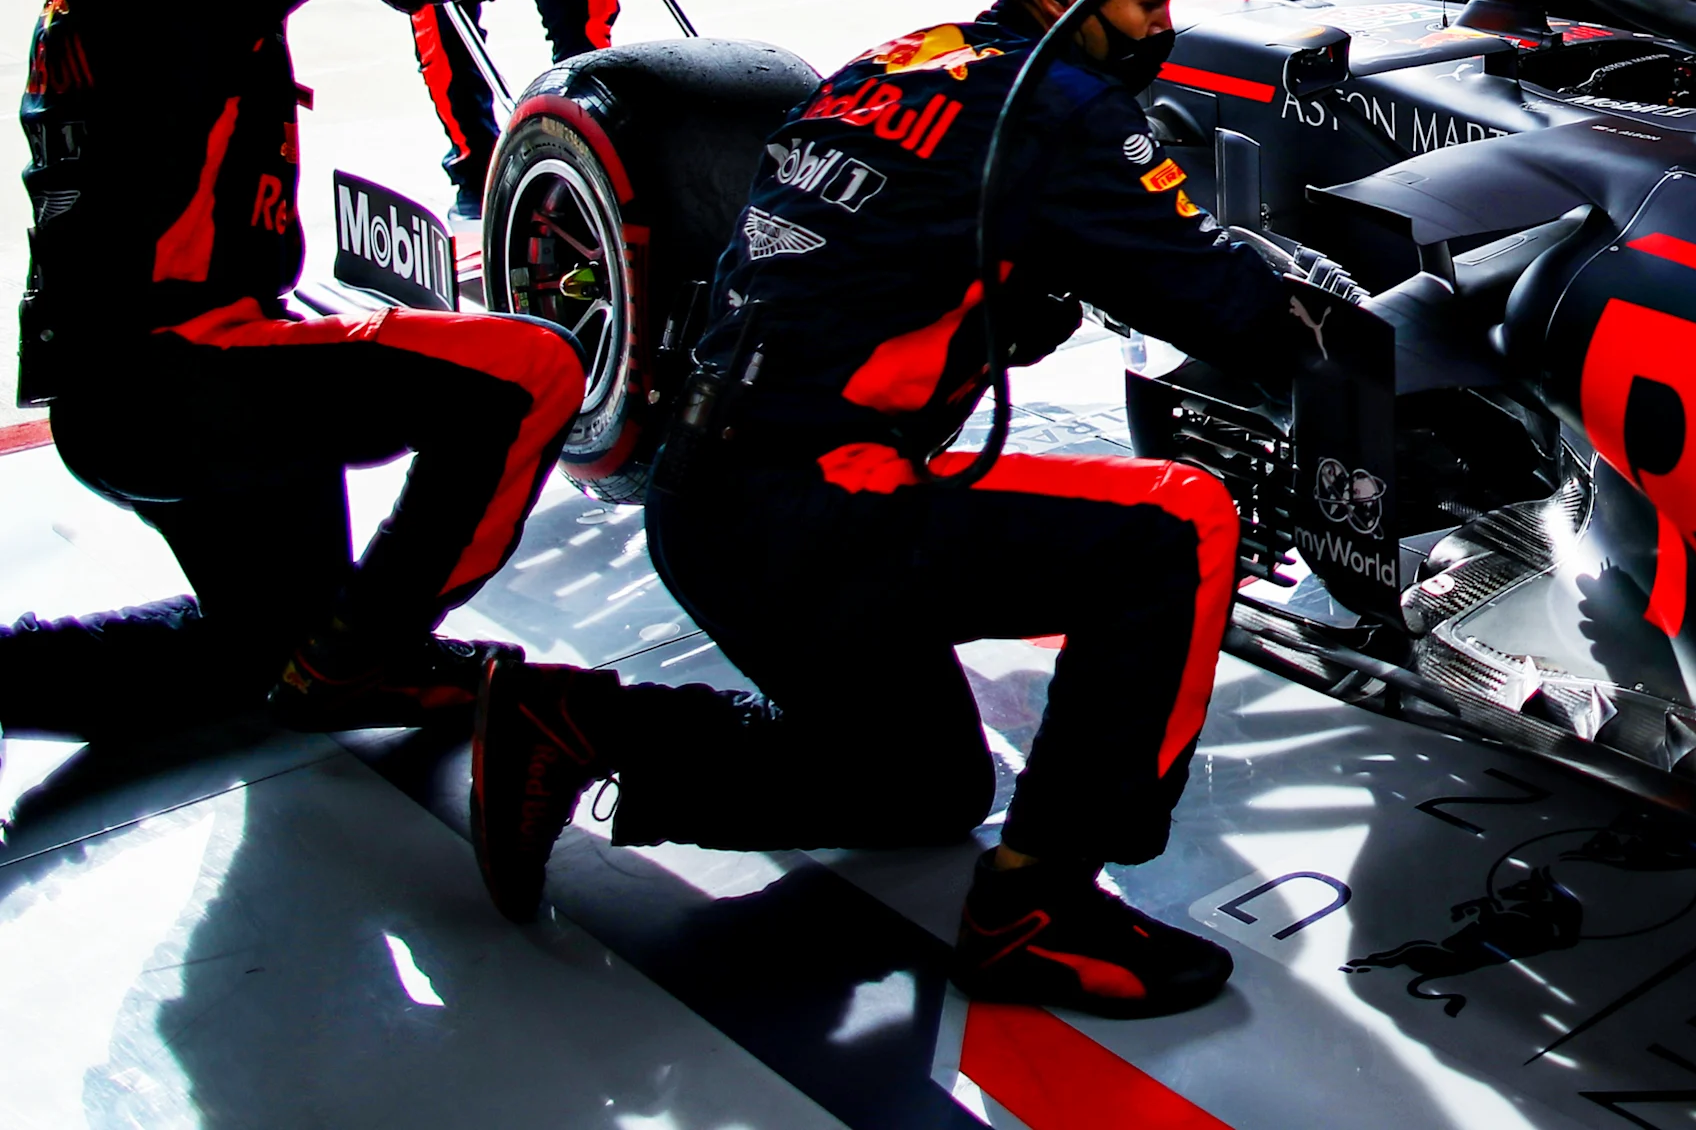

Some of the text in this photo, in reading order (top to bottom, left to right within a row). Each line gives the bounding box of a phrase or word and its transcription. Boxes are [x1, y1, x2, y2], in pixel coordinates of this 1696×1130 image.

[1412, 107, 1512, 153] MAR
[337, 183, 432, 291] Mobil
[1294, 525, 1397, 588] myWorld
